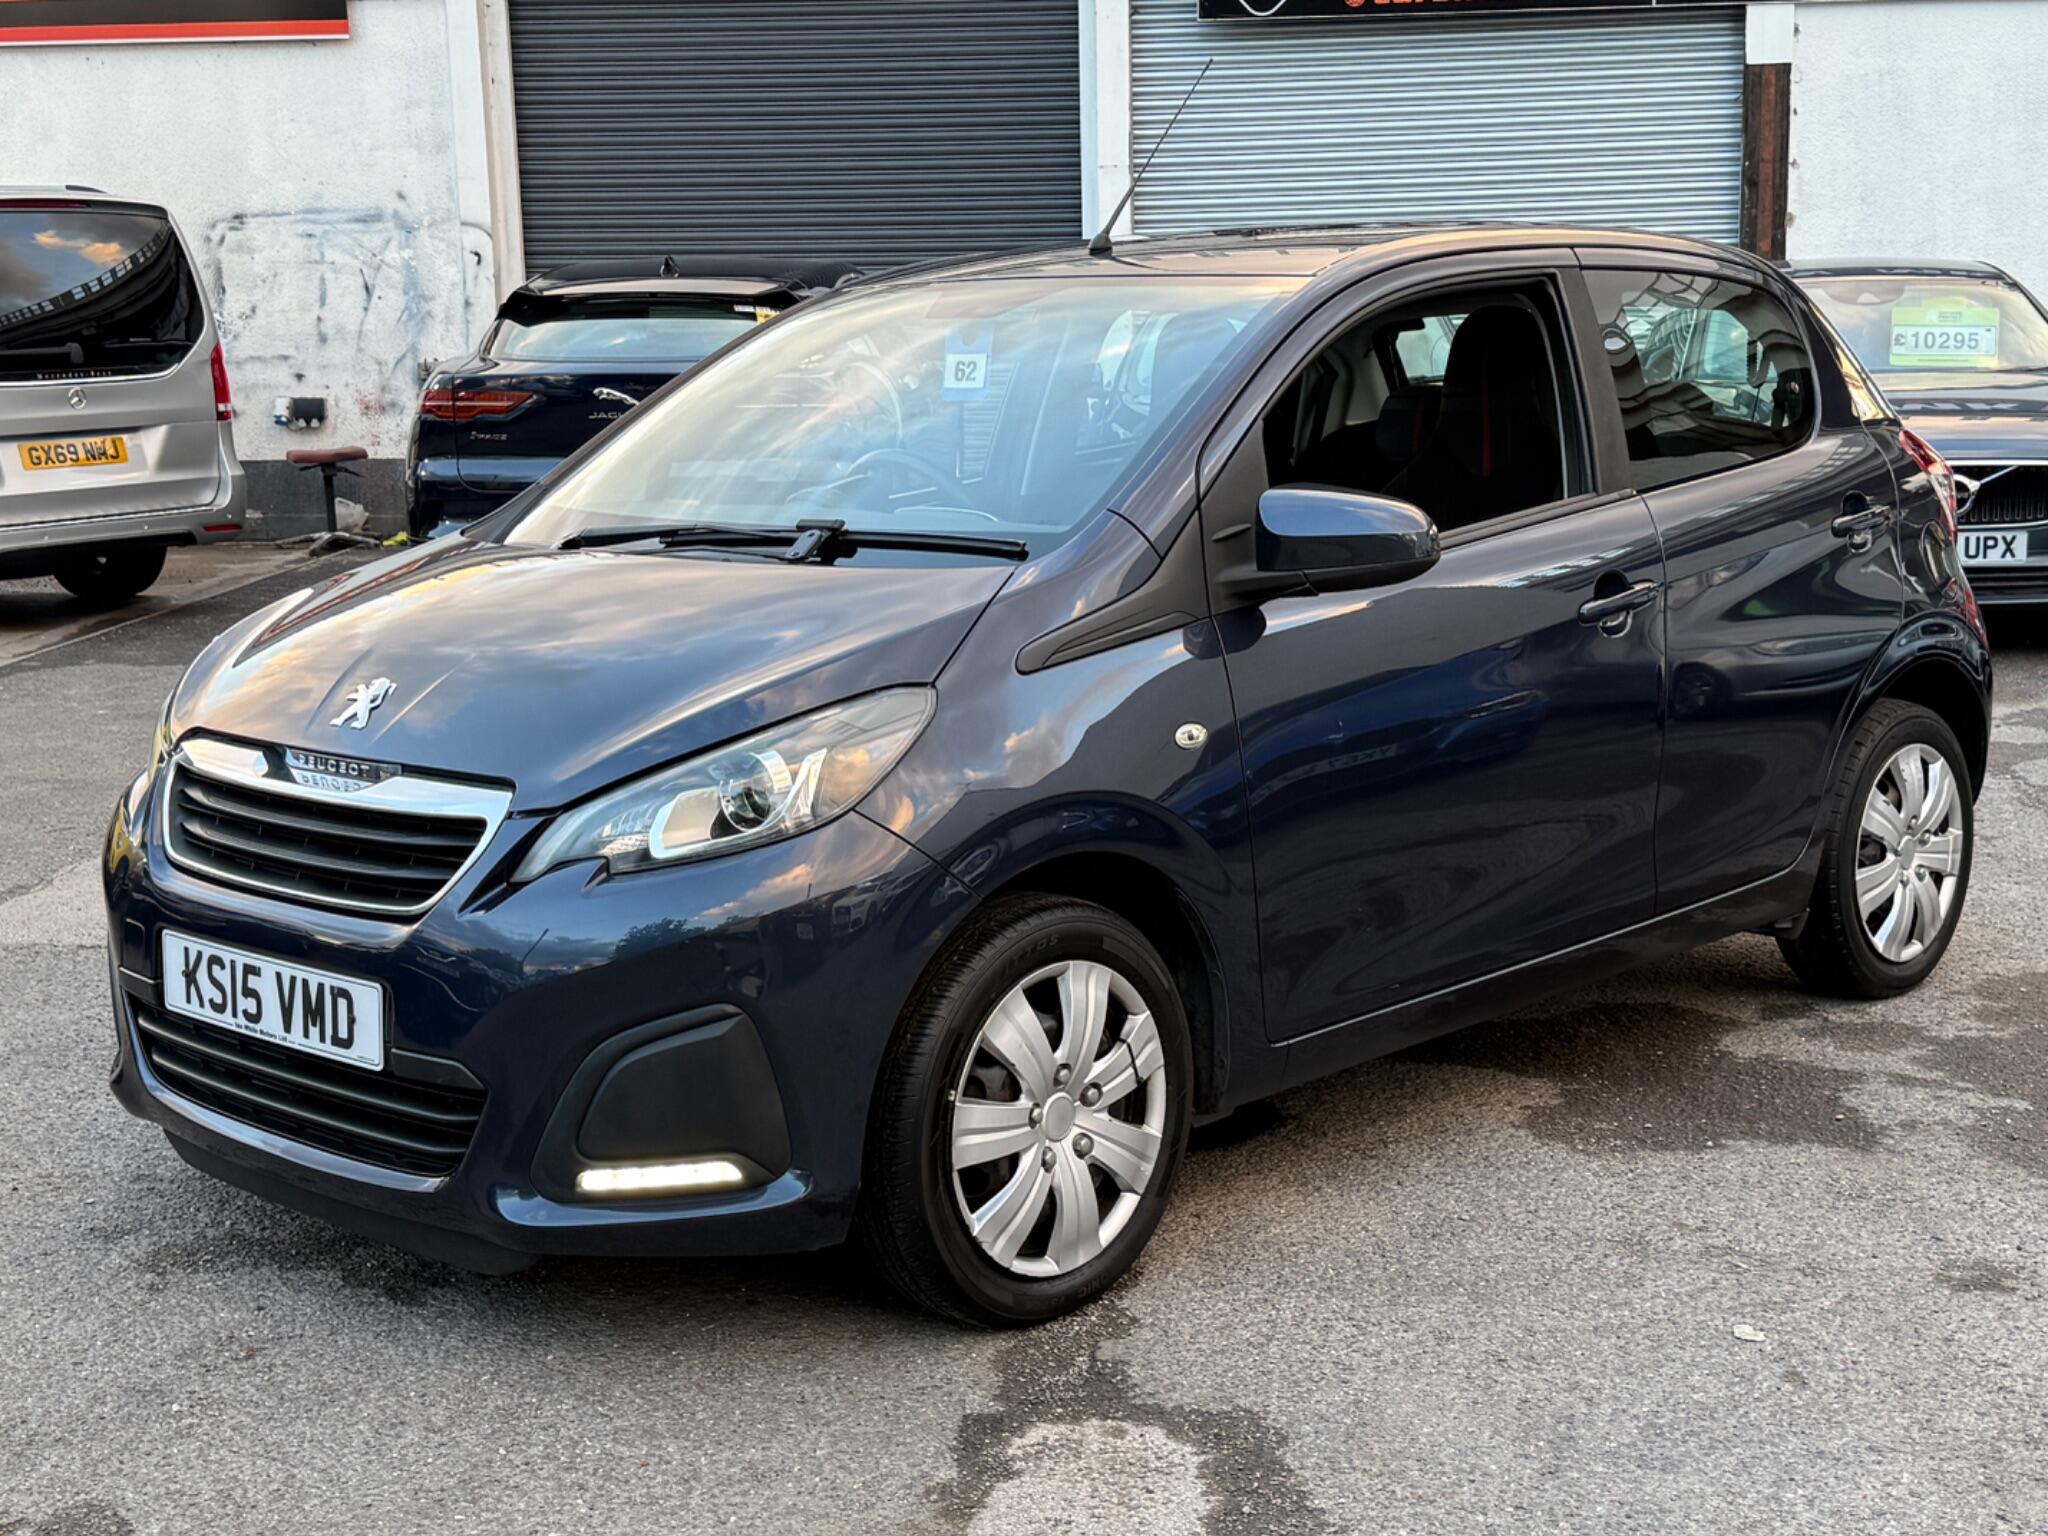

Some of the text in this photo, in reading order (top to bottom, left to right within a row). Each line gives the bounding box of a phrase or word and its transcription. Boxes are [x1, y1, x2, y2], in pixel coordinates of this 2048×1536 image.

[954, 360, 977, 382] 62
[27, 443, 79, 466] GX69
[1964, 535, 2016, 559] UPX
[298, 753, 370, 777] PEUGEOT
[182, 945, 356, 1051] KS15 VMD
